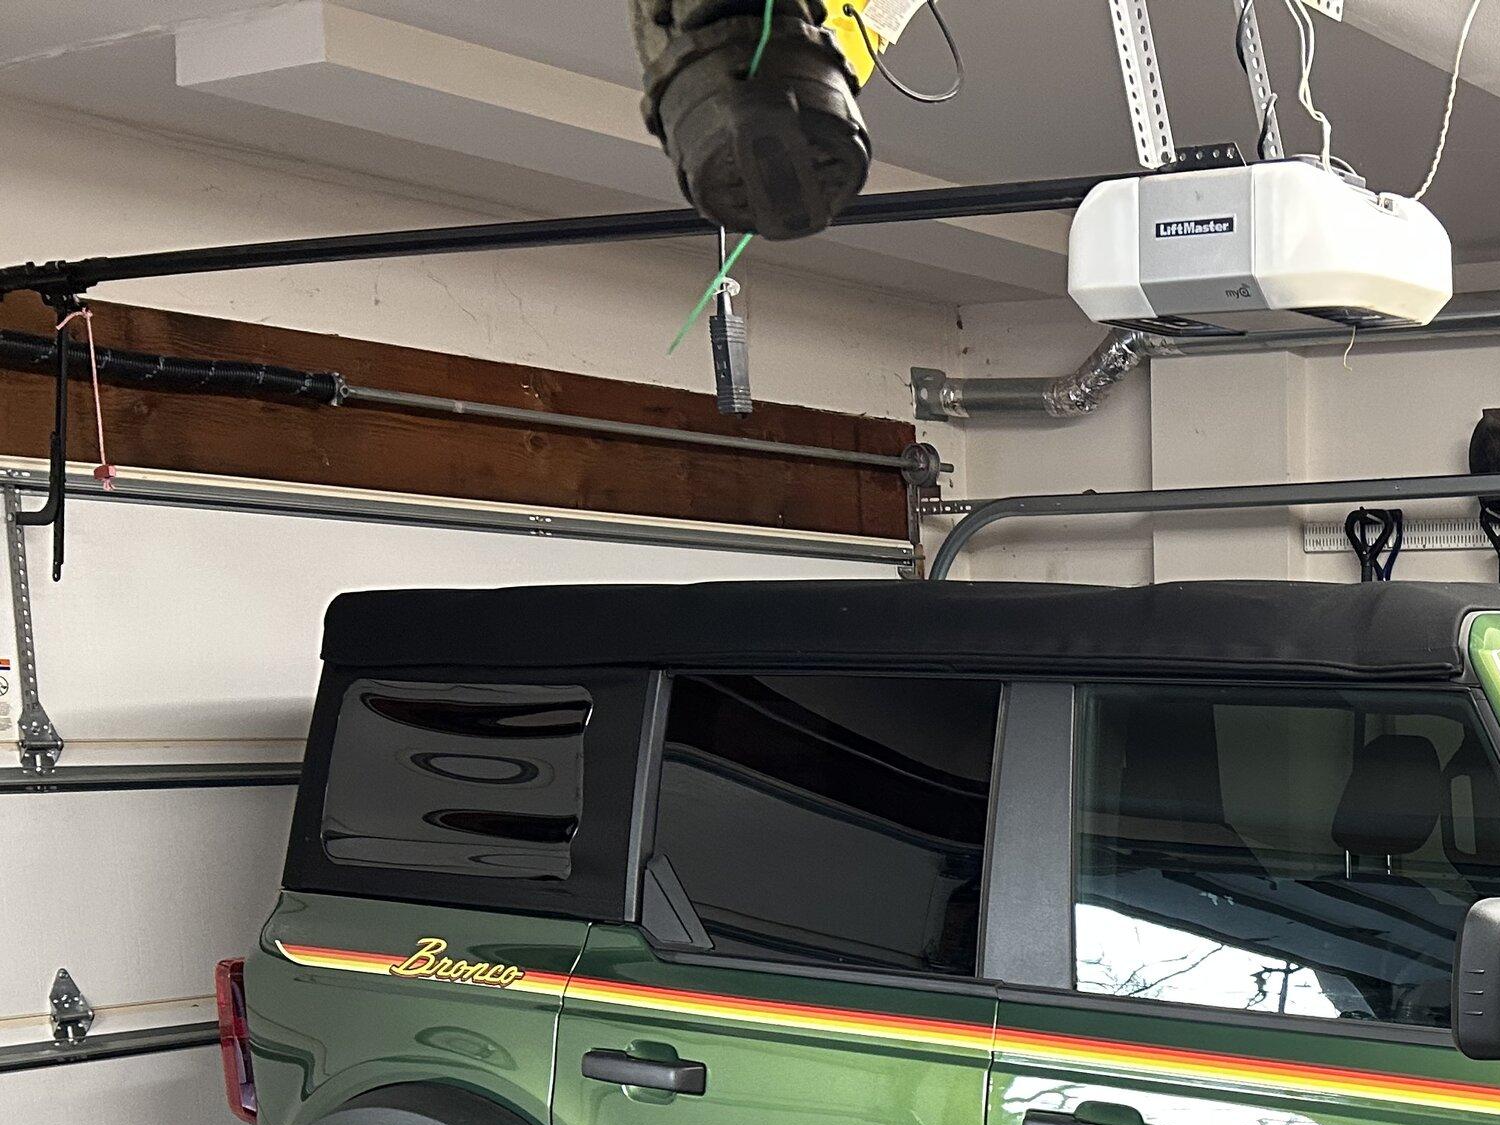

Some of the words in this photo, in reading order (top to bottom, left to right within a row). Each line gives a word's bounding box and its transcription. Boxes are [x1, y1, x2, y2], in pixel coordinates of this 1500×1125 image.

[1159, 220, 1230, 237] LiftMaster
[1225, 285, 1251, 299] myQ
[389, 937, 525, 987] Bronco
